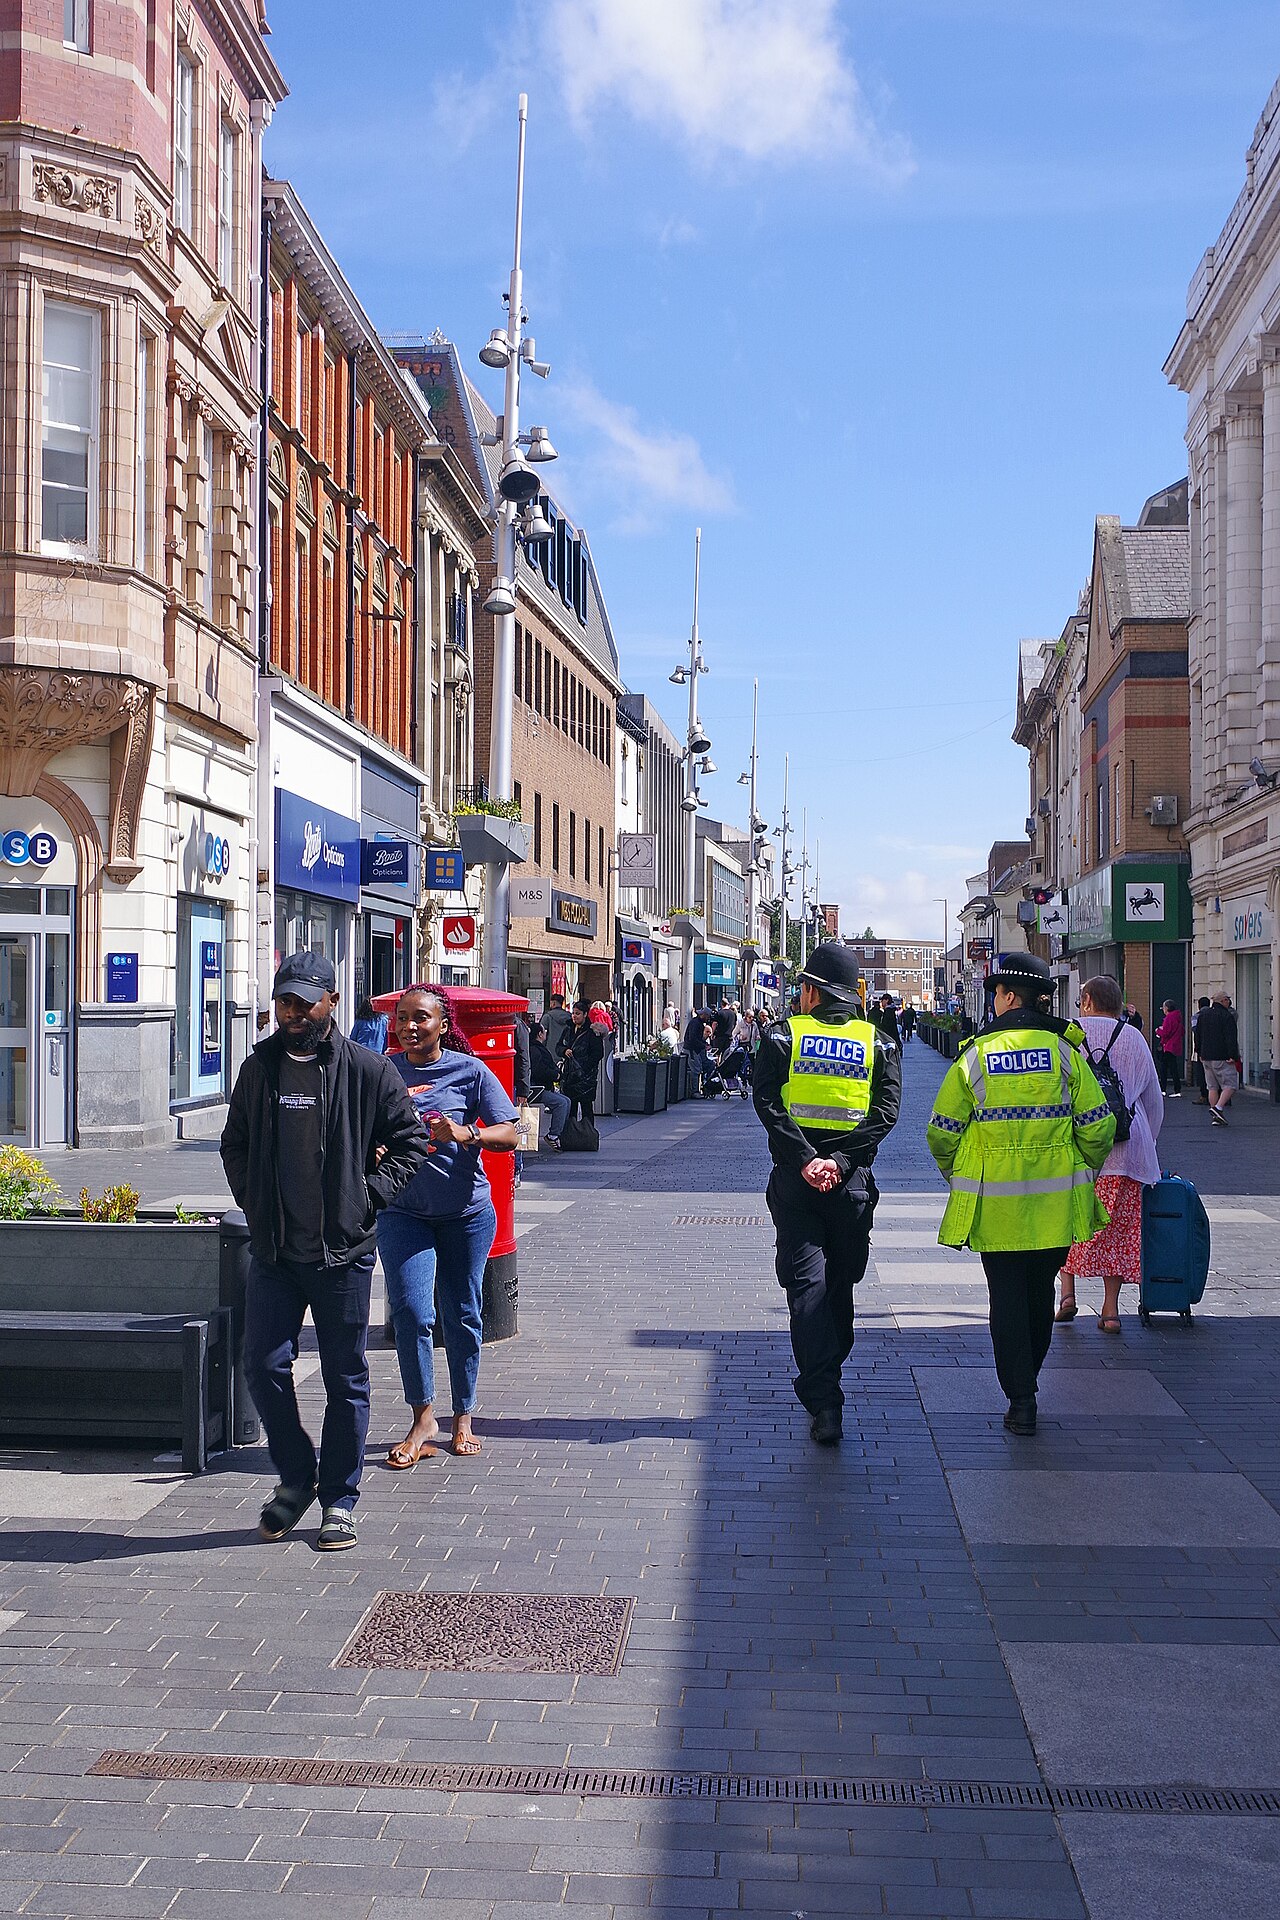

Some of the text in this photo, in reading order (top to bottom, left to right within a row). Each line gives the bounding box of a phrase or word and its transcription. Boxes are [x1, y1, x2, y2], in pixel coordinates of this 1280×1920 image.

[302, 820, 345, 870] Boots Opticians
[373, 850, 404, 866] Boots
[373, 868, 404, 877] Opticians
[518, 890, 543, 900] M&S
[1234, 903, 1263, 942] savers
[803, 1037, 863, 1061] POLICE
[988, 1051, 1049, 1071] POLICE
